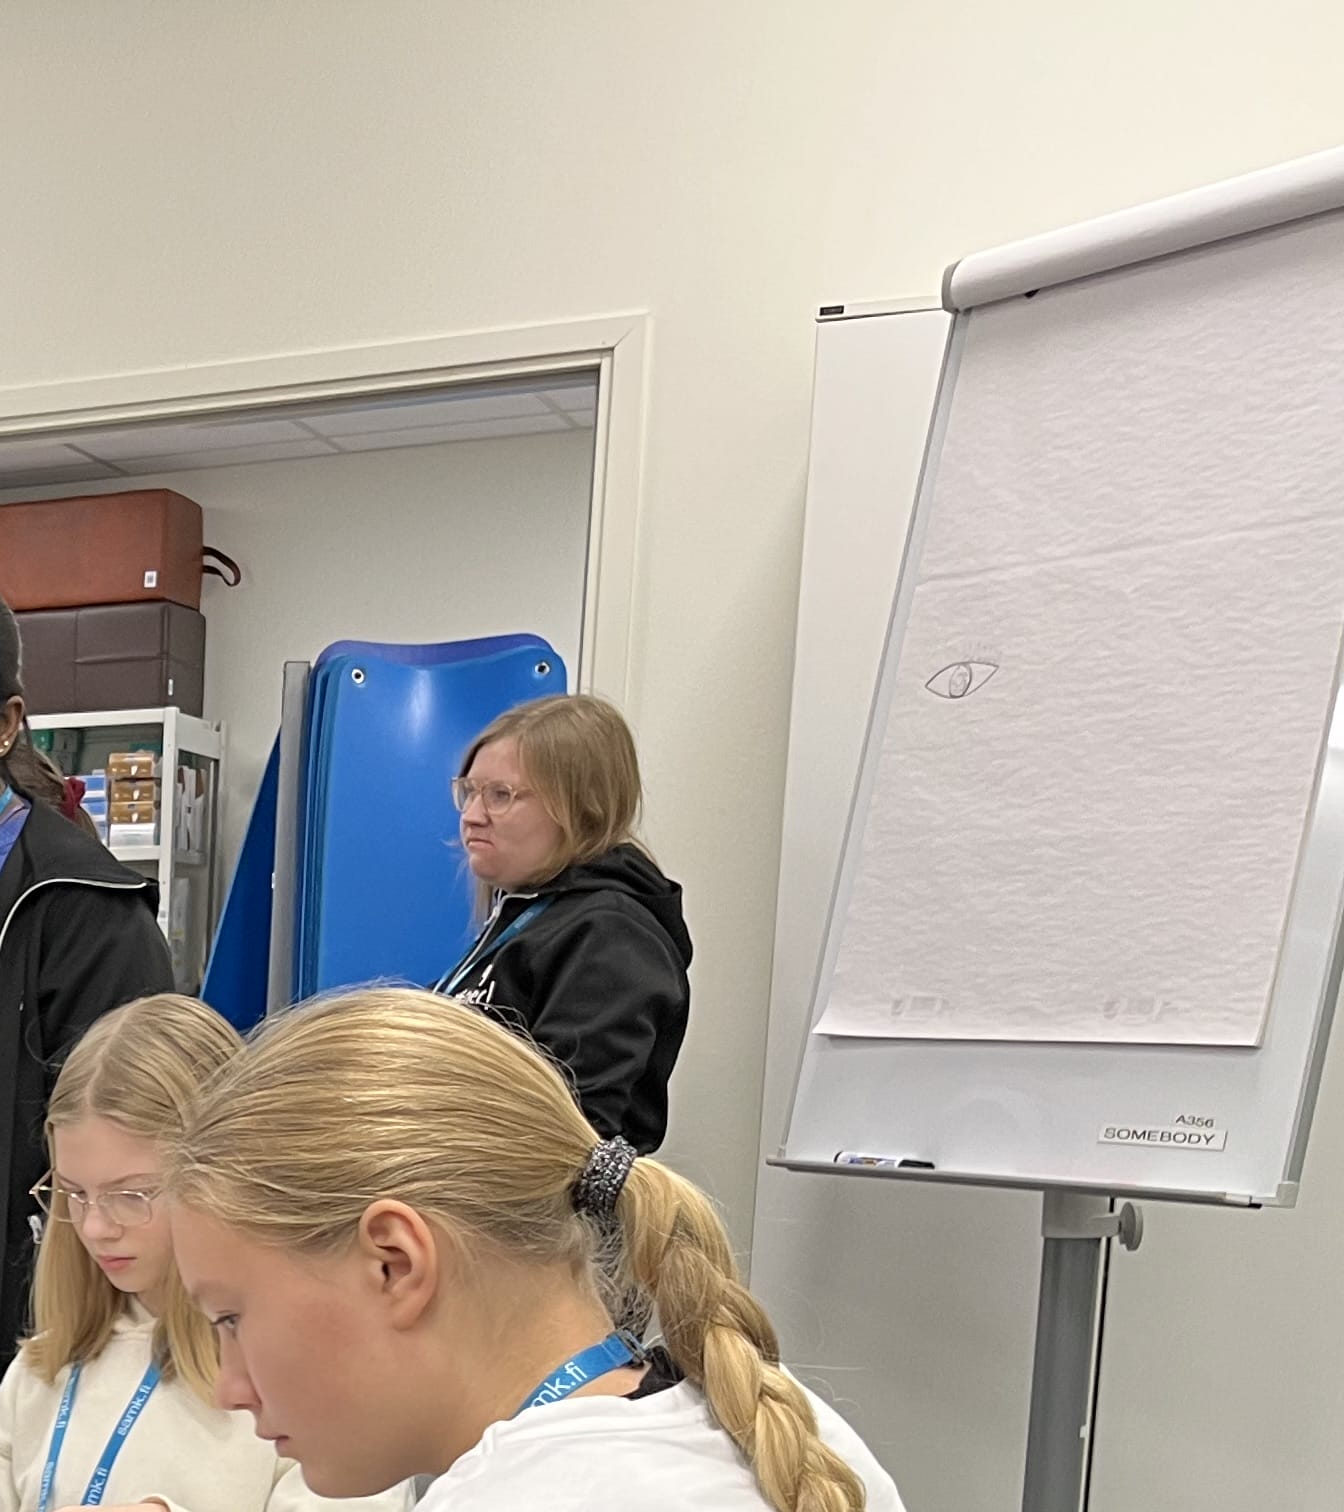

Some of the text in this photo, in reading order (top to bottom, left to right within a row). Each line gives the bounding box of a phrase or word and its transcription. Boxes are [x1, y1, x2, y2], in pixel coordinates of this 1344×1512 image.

[1103, 1126, 1216, 1146] SOMEBODY
[1176, 1114, 1215, 1129] A356
[530, 1361, 588, 1409] mk.fi
[116, 1384, 153, 1437] samk.fi
[87, 1467, 109, 1507] mk.fi
